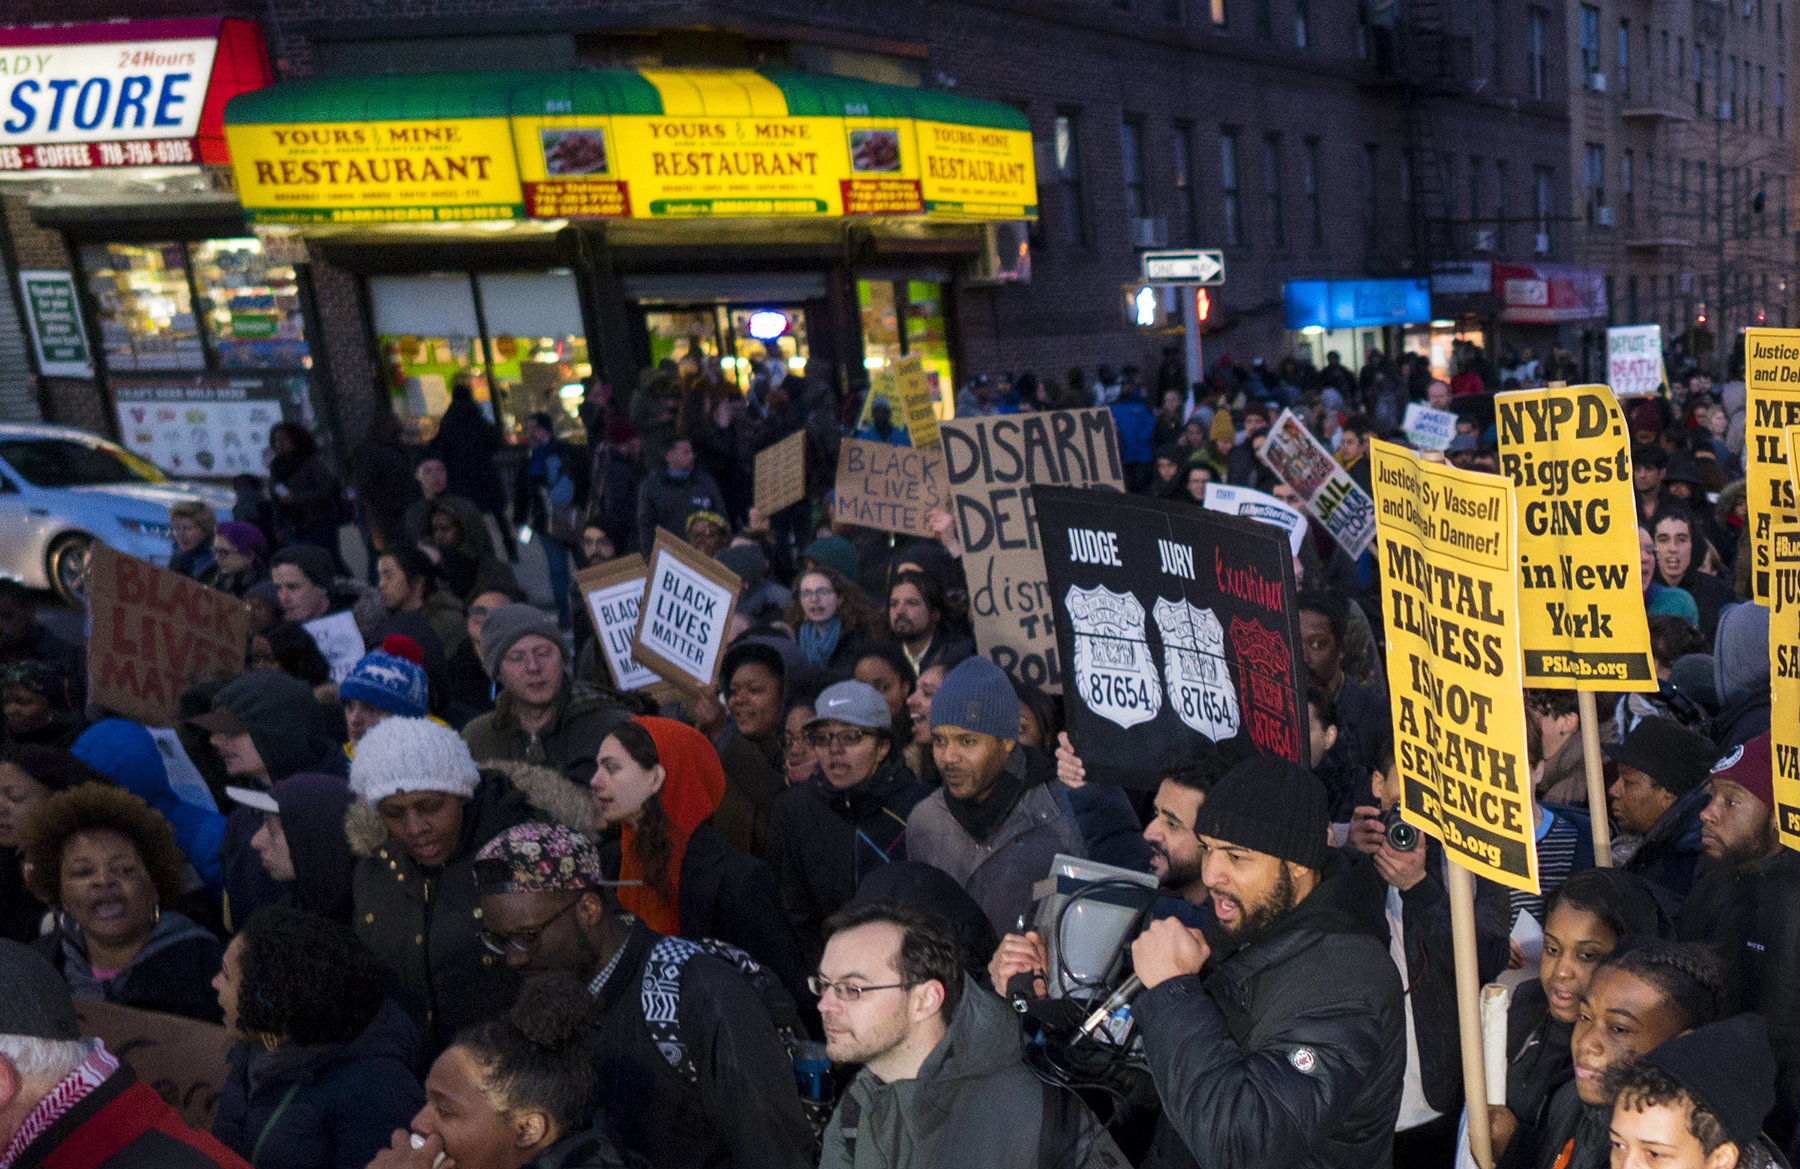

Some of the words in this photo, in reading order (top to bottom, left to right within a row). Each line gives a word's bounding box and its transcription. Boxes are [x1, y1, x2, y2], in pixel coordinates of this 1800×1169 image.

[118, 50, 196, 69] 24Hours
[3, 71, 192, 134] STORE
[273, 128, 366, 146] YOURS
[389, 126, 462, 144] MINE
[648, 122, 727, 139] YOURS
[755, 123, 813, 140] MINE
[933, 127, 976, 145] YOURS
[980, 134, 1011, 149] MINE
[34, 143, 92, 168] COFFEE
[254, 155, 491, 186] RESTAURANT
[652, 151, 819, 177] RESTAURANT
[927, 155, 1026, 185] RESTAURANT
[1752, 342, 1800, 362] Justice
[1753, 366, 1778, 383] and
[1499, 393, 1623, 446] NYPD:
[849, 447, 940, 484] BLACK
[940, 408, 1123, 485] DISARM
[1501, 445, 1630, 497] Biggest
[864, 476, 940, 510] LIVES
[1315, 477, 1352, 521] JAIL
[1421, 481, 1440, 512] Sy
[1442, 485, 1501, 522] Vassell
[1382, 497, 1405, 518] and
[1439, 519, 1500, 557] Danner!
[1524, 498, 1612, 537] GANG
[1067, 527, 1123, 568] JUDGE
[1157, 538, 1196, 581] JURY
[1520, 554, 1557, 590] in
[1560, 554, 1630, 591] New
[115, 556, 239, 642] BLACK
[662, 568, 717, 620] BLACK
[656, 594, 711, 645] LIVES
[1545, 601, 1614, 639] York
[652, 620, 704, 666] MATTER
[1089, 673, 1151, 711] 87654
[1181, 685, 1234, 728] 87654
[1399, 695, 1420, 738] A
[1400, 739, 1524, 836] SENENCE
[1421, 789, 1502, 869] PSeb.org
